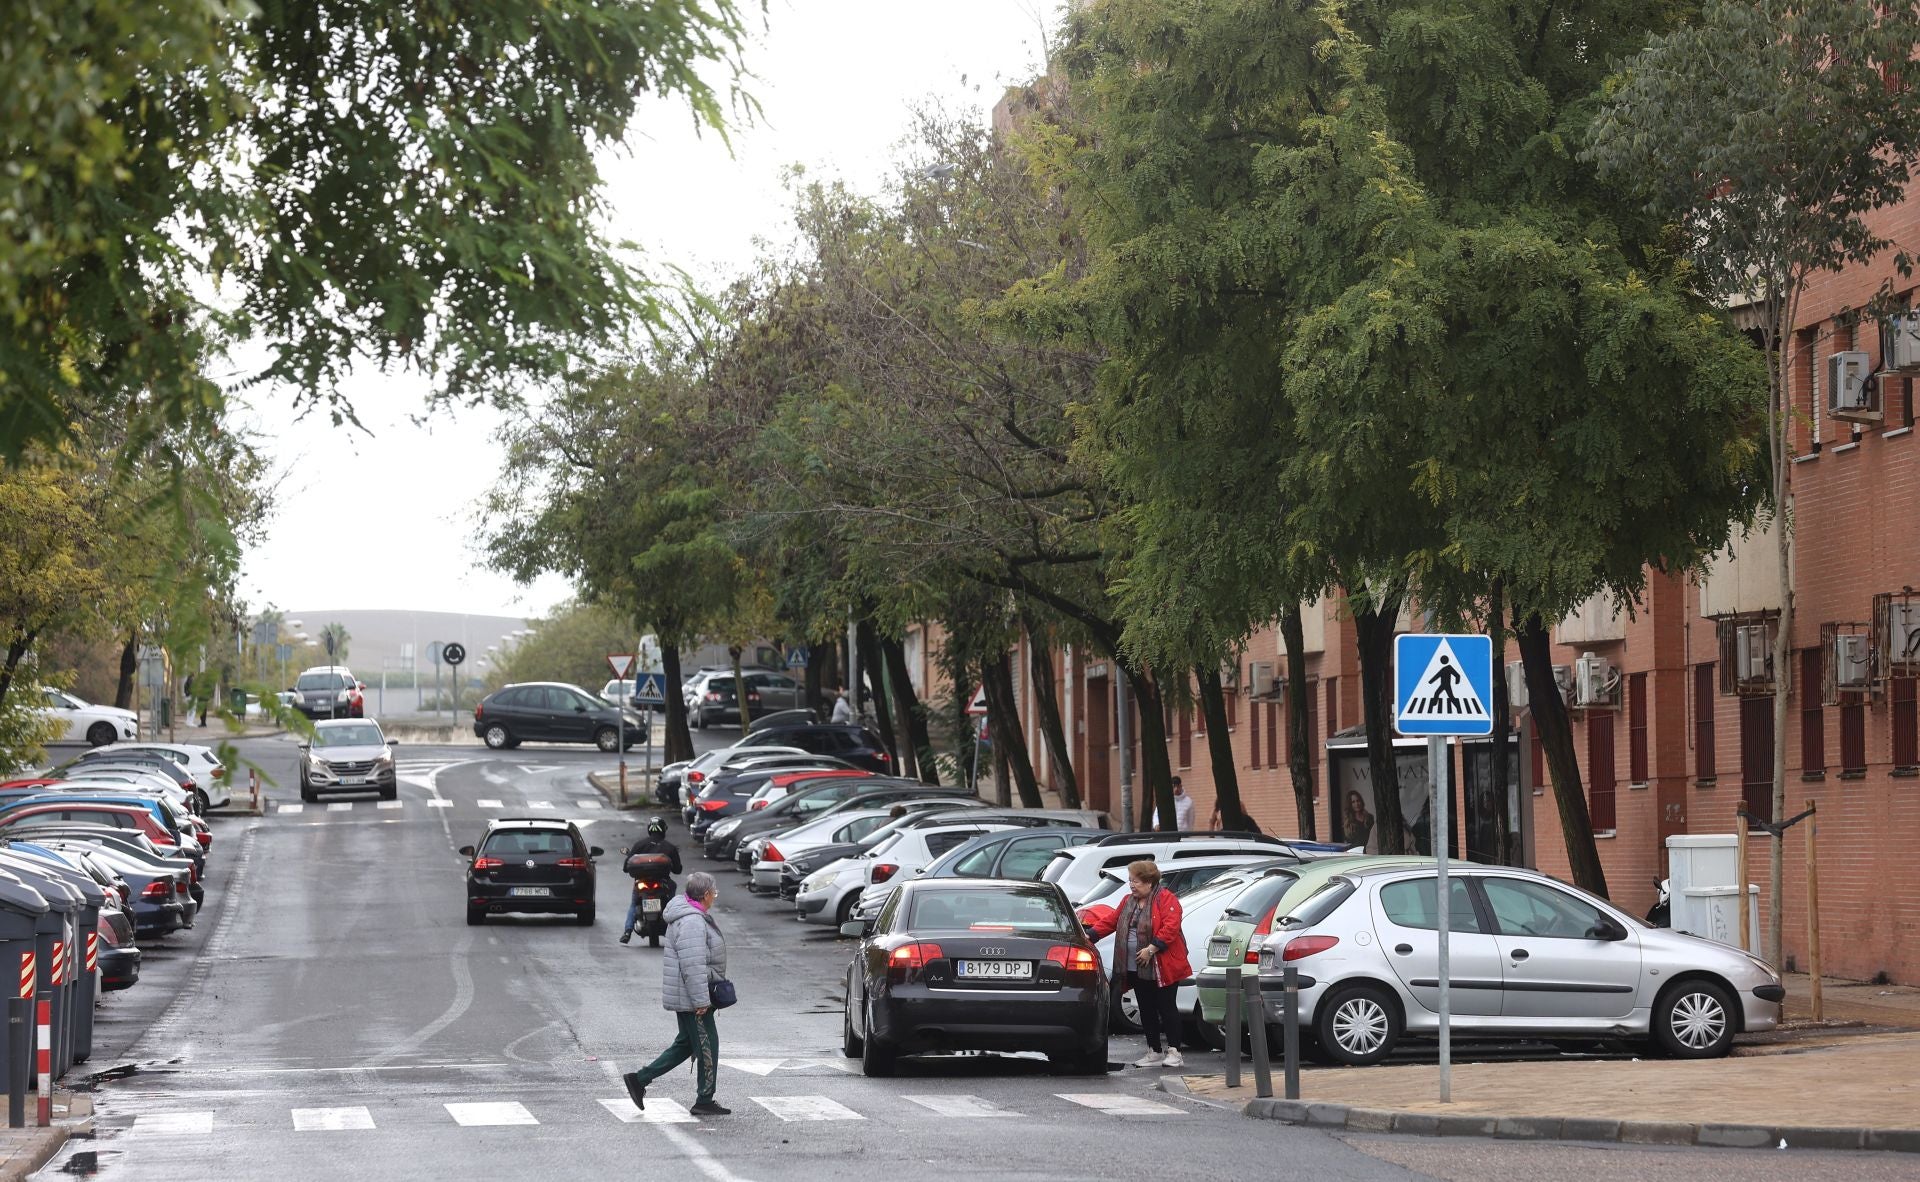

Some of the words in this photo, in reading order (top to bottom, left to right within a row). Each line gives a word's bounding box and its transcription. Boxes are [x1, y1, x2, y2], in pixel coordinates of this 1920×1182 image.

[1352, 765, 1429, 780] WAN
[967, 962, 1001, 975] 8179
[1005, 962, 1030, 975] DPJ
